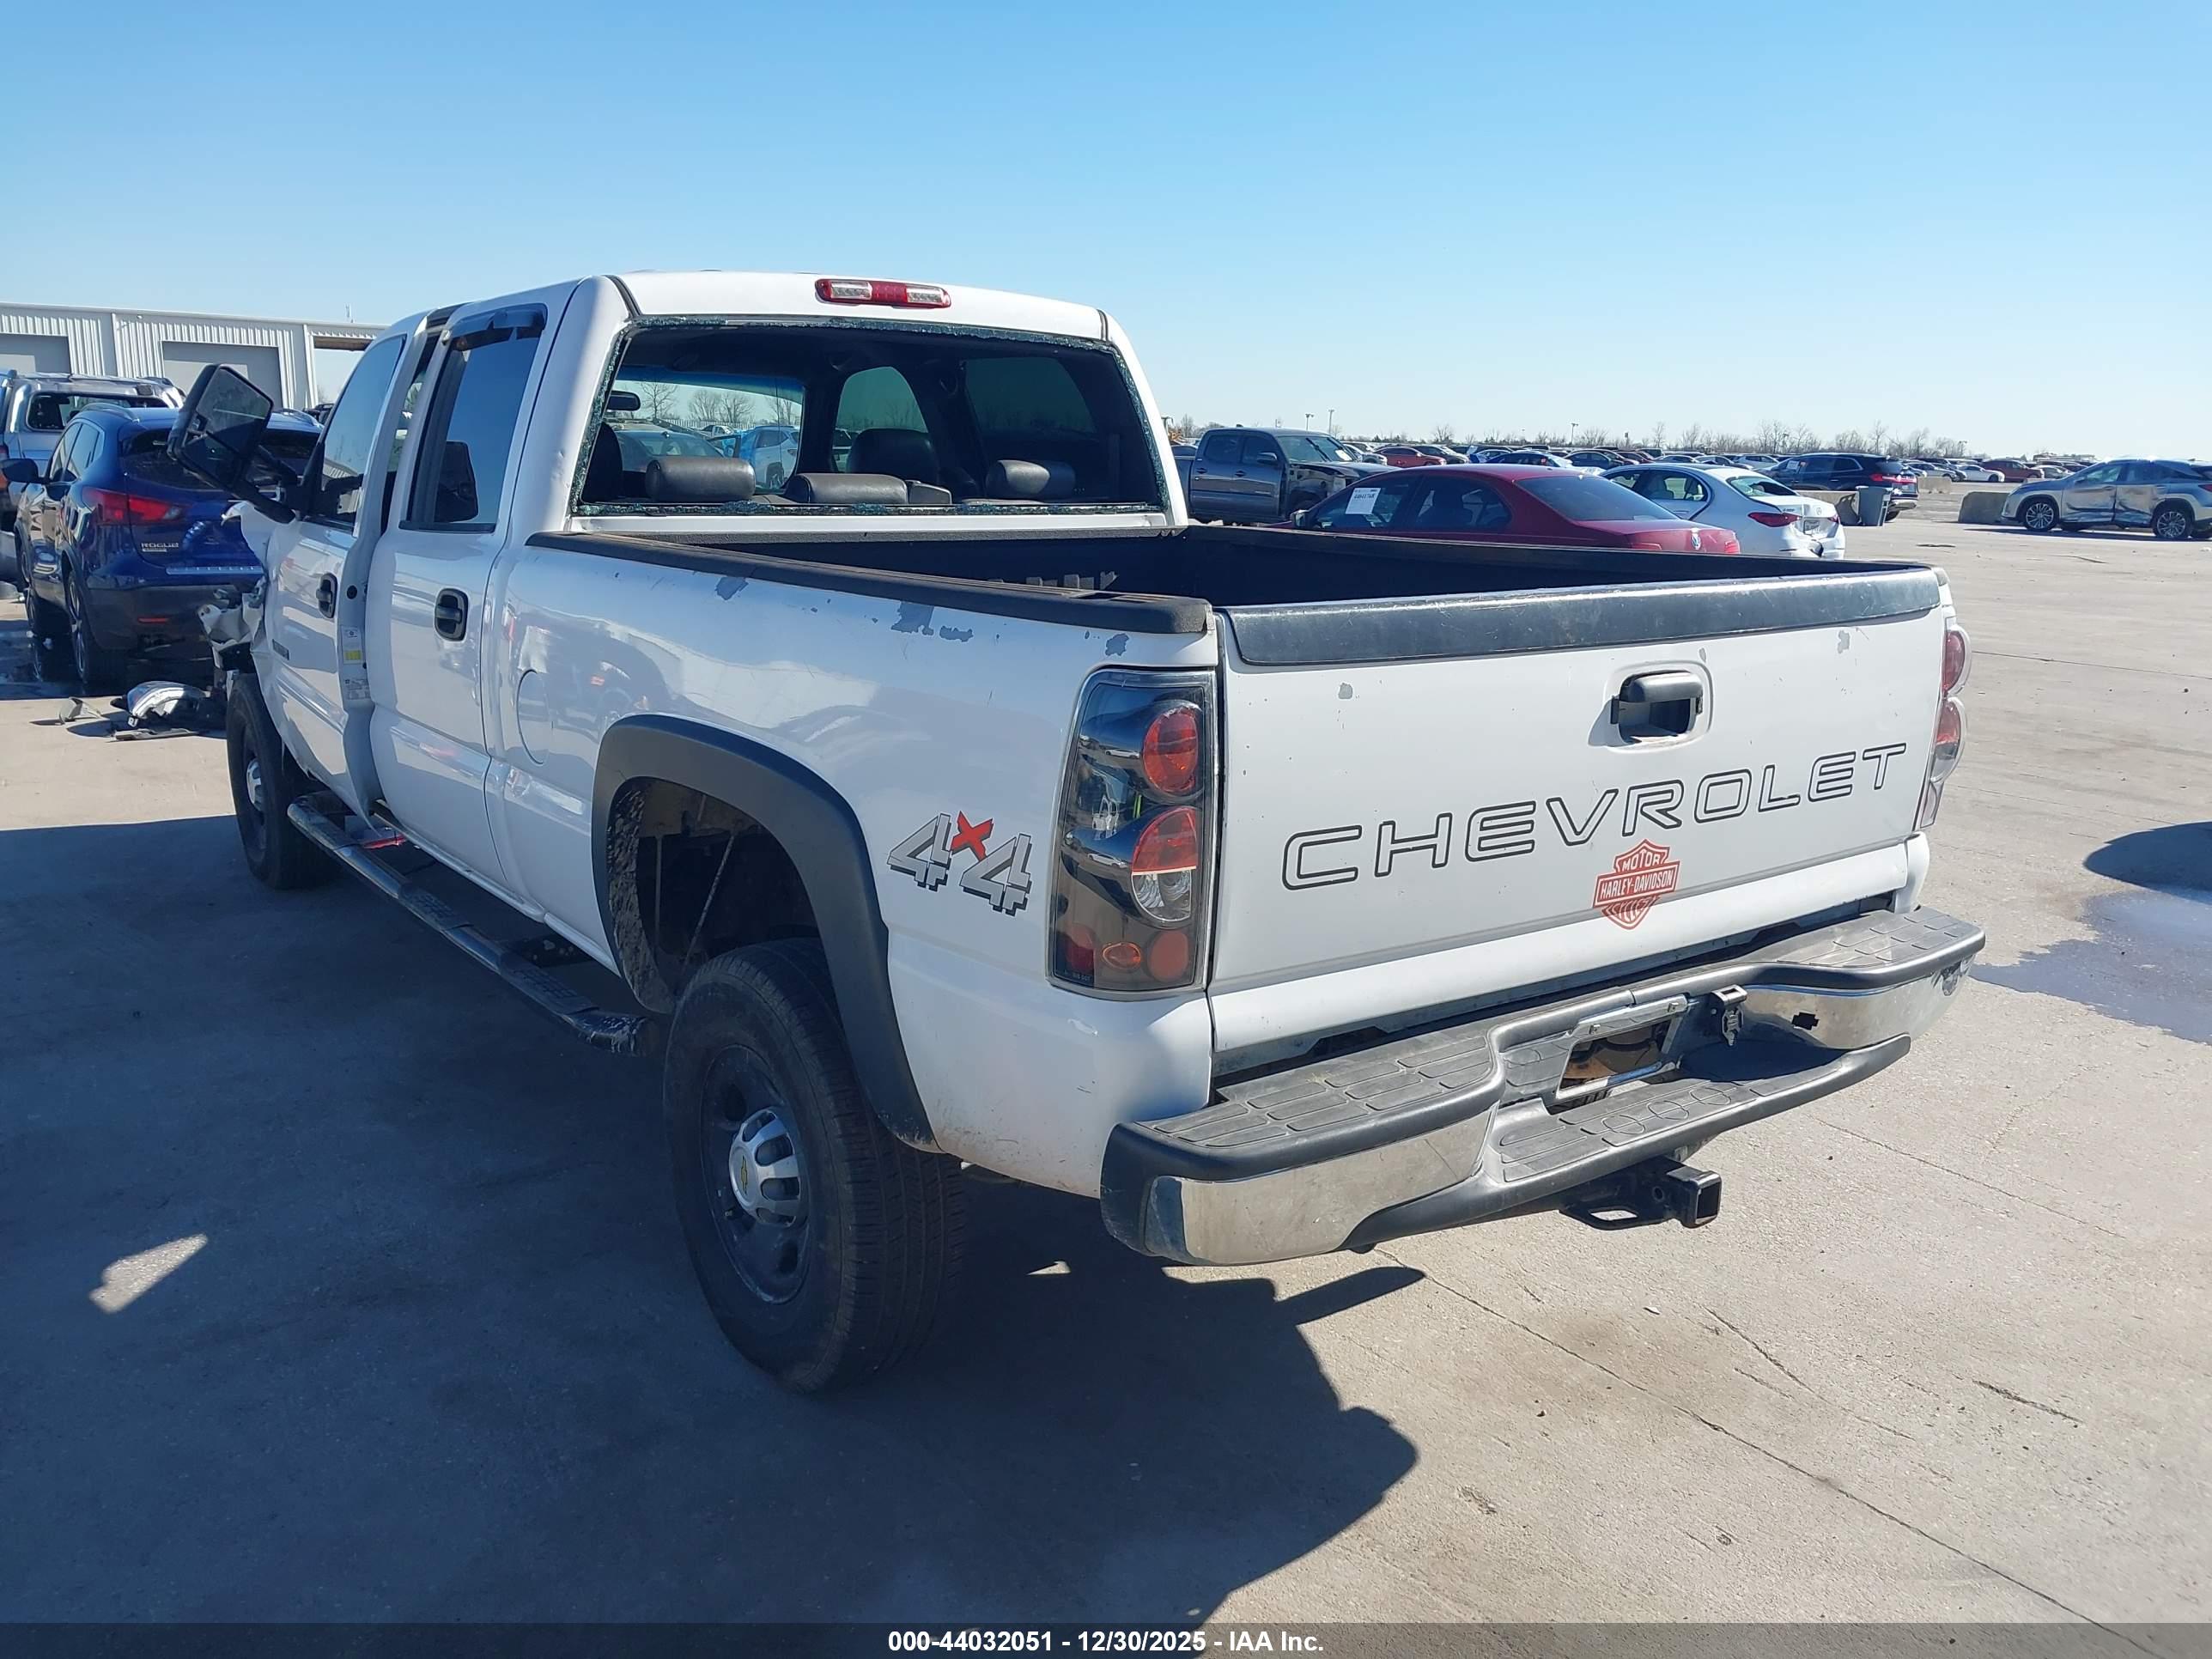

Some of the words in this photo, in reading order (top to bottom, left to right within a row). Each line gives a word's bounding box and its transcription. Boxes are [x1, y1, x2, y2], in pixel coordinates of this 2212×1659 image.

[1282, 742, 1906, 891] CHEVROLET
[1621, 848, 1662, 872] MOTOR
[1599, 869, 1674, 900] HARLEY-DAVIDSON
[1611, 896, 1650, 922] CYCLES
